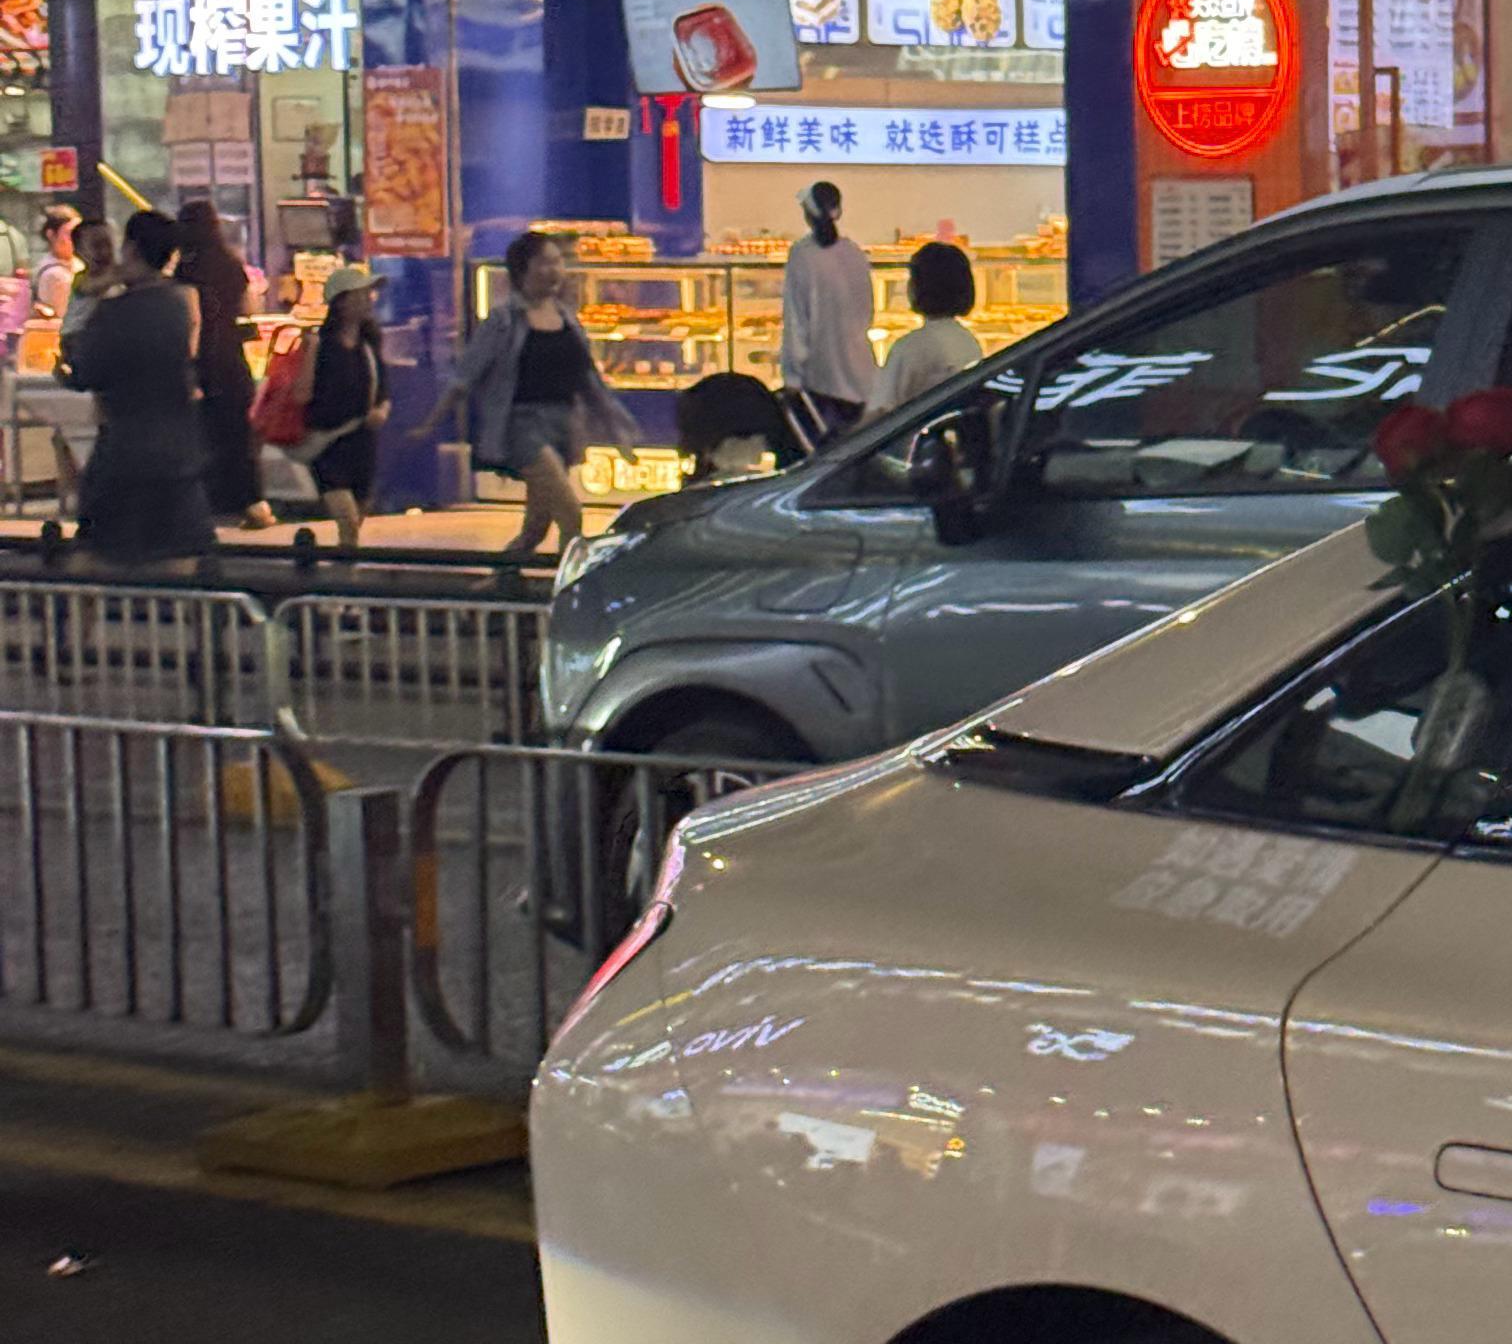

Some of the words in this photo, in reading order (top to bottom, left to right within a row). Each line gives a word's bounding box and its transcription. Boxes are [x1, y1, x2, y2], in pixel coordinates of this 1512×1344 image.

[726, 116, 859, 154] 新鲜美味
[885, 119, 1066, 155] 就选酥可糕点
